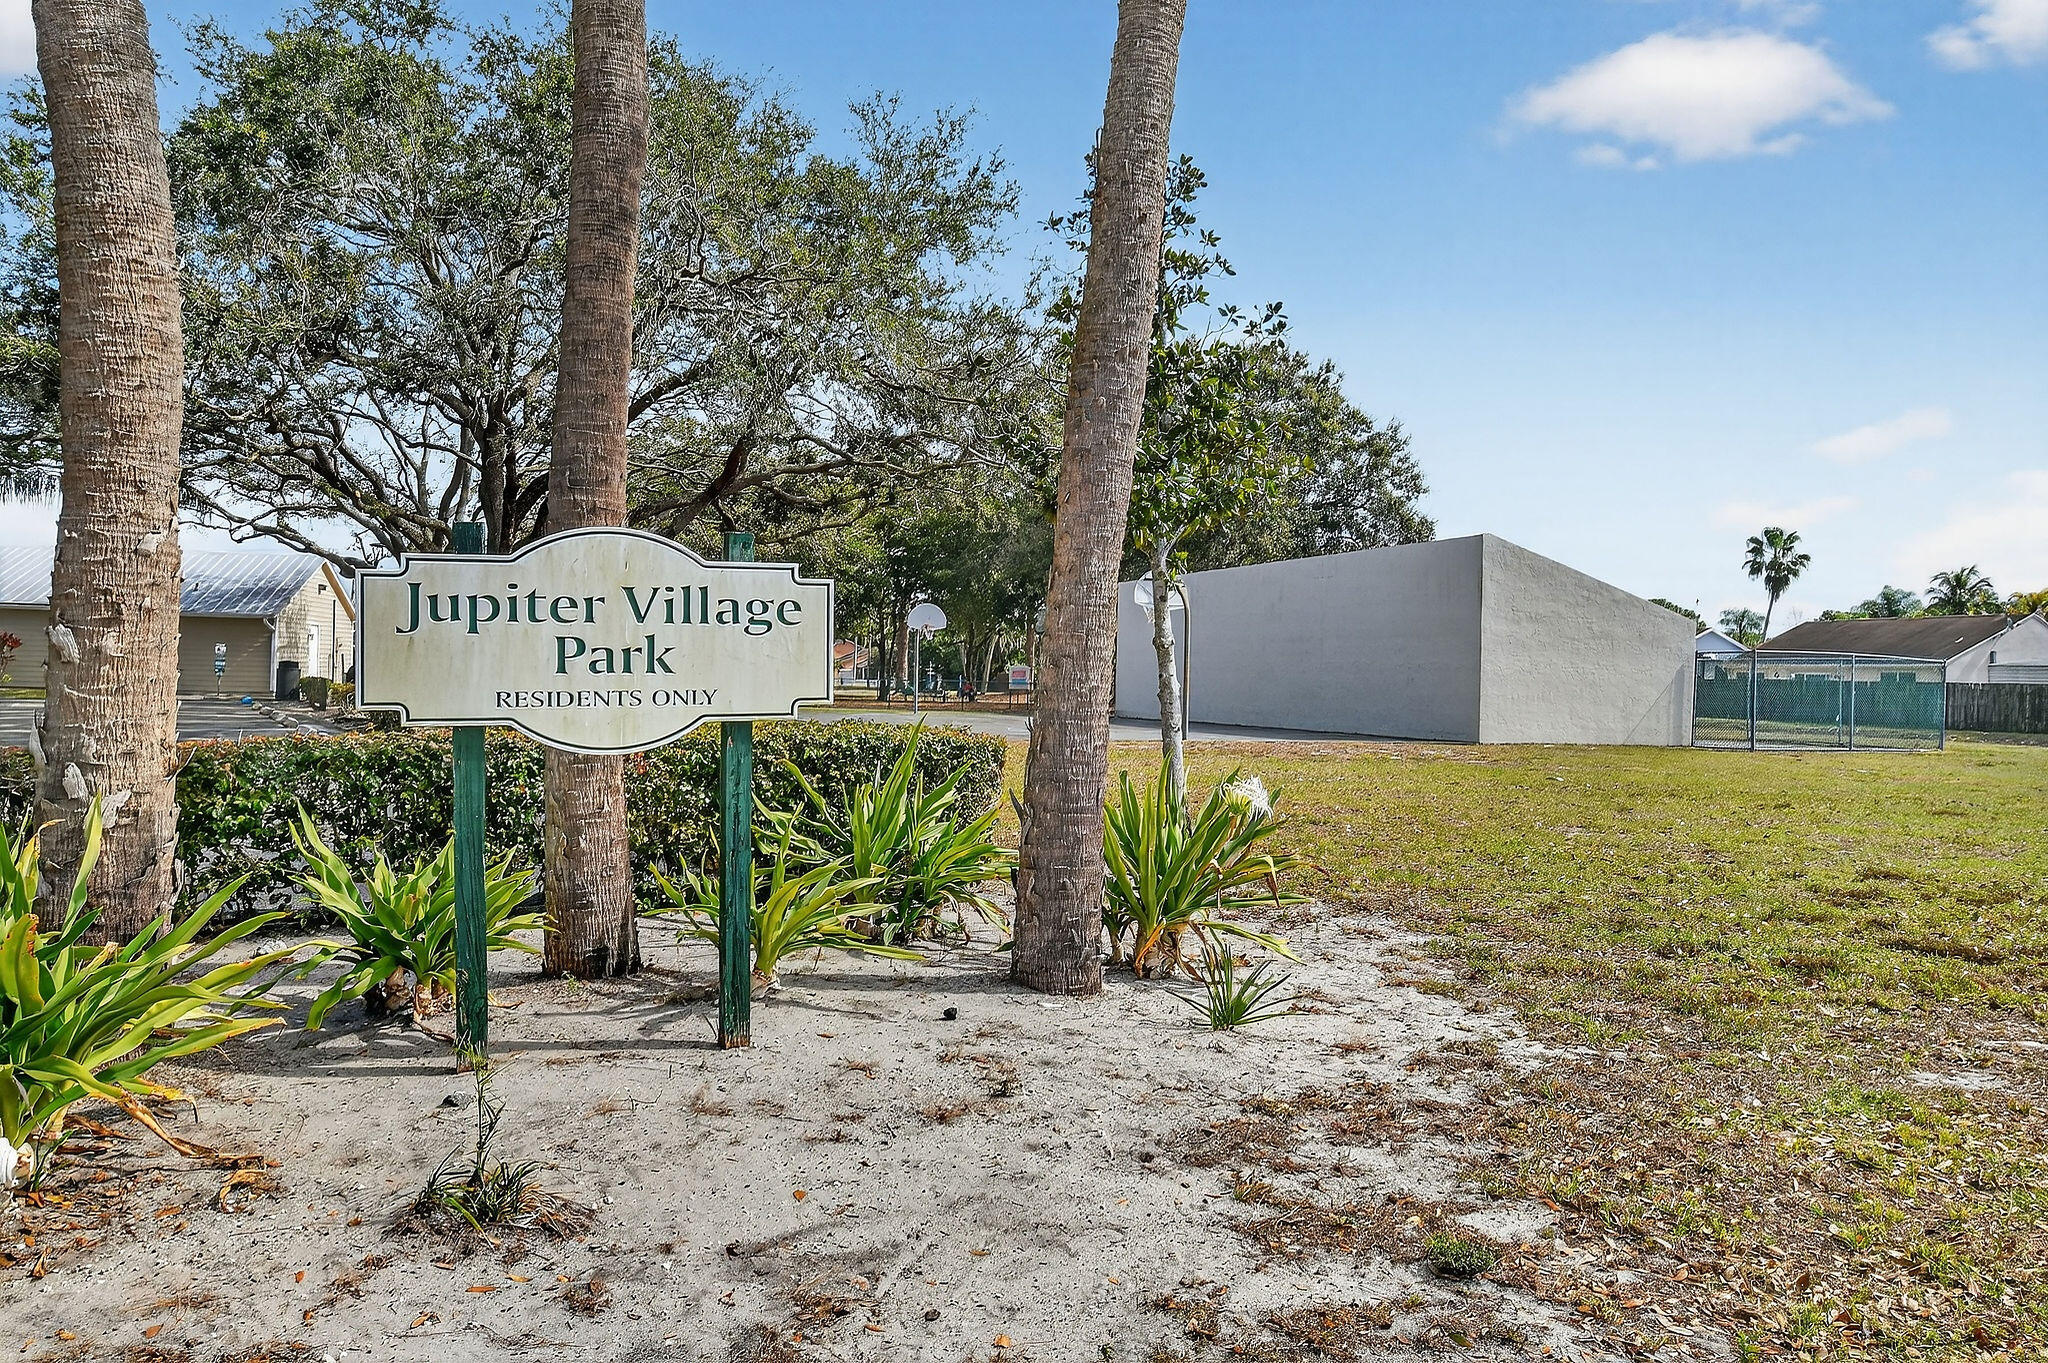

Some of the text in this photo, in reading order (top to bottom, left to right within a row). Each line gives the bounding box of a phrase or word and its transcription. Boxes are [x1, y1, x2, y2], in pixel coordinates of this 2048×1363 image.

[395, 582, 802, 636] Jupiter Village
[554, 634, 676, 676] Park
[496, 689, 718, 708] RESIDENTS ONLY
